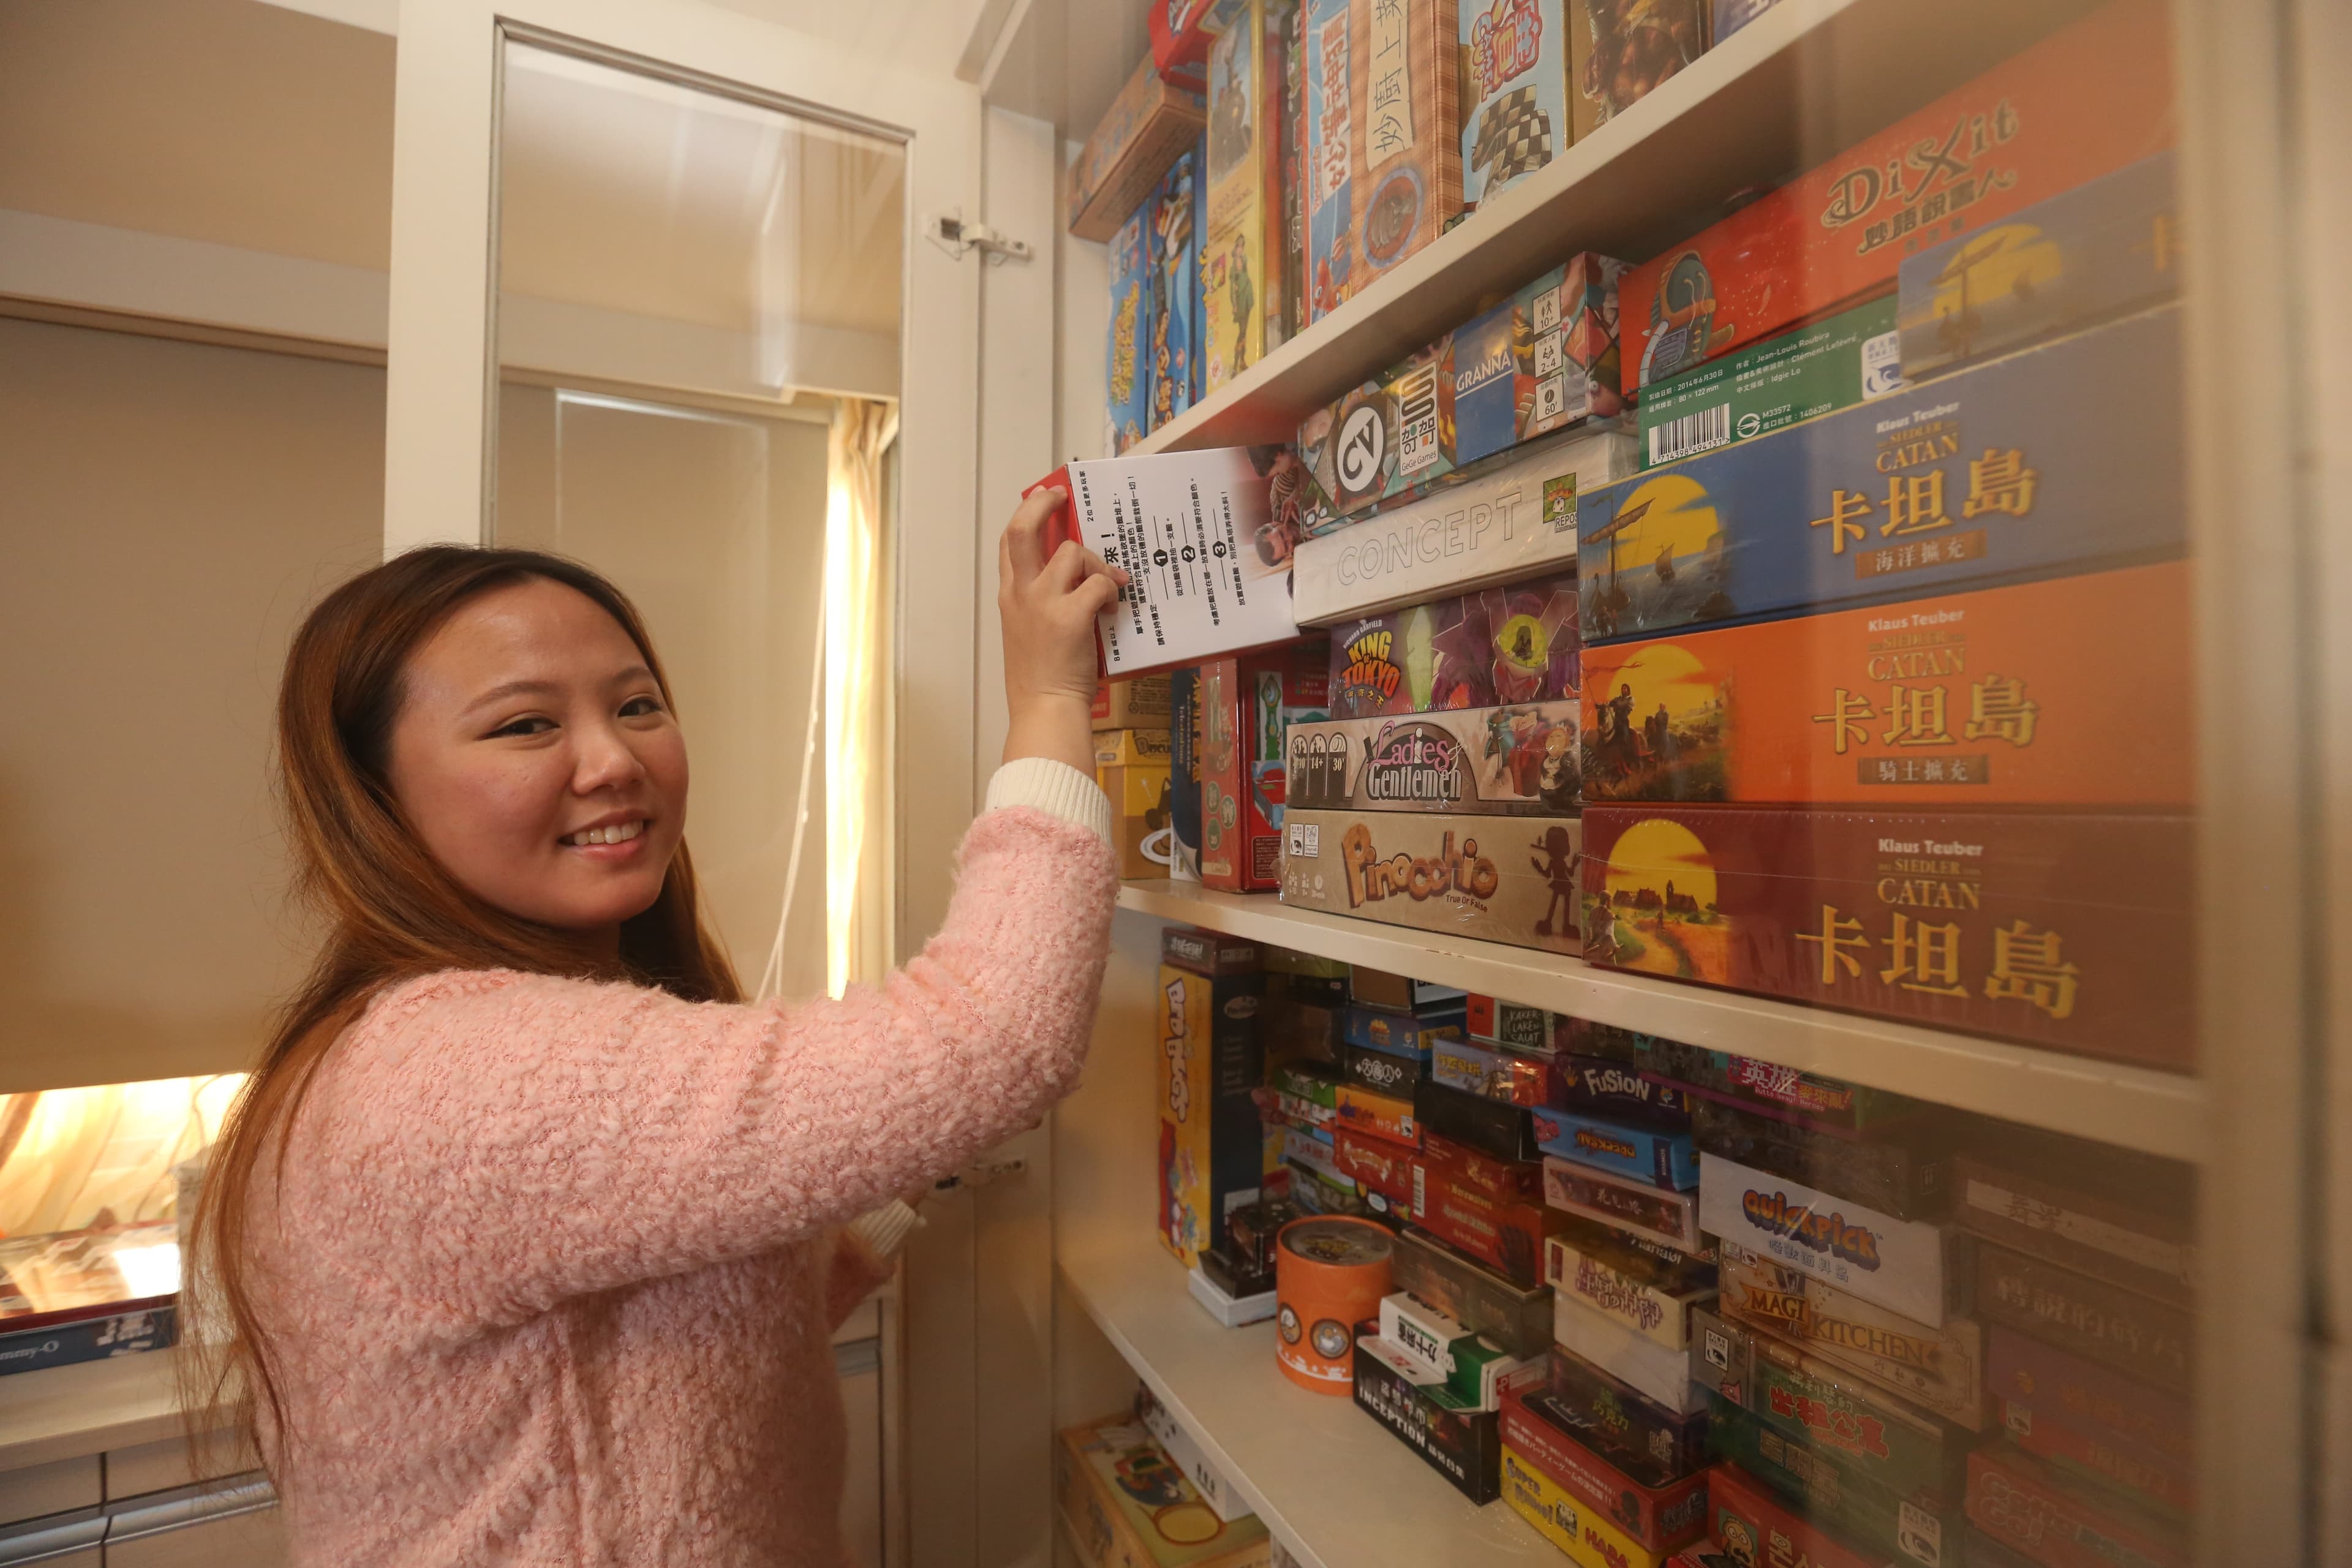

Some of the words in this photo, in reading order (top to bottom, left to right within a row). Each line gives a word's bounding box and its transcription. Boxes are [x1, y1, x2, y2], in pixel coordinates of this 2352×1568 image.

[1540, 316, 1554, 329] 10+
[1756, 344, 1798, 363] Jean-Louis
[1798, 331, 1830, 348] Roubira
[1456, 350, 1511, 393] GRANNA
[1541, 358, 1556, 372] 2-4
[1791, 368, 1801, 376] Lo
[1762, 404, 1792, 419] M33572
[1800, 402, 1833, 418] 1406209
[1875, 417, 1910, 434] Klaus
[1913, 401, 1961, 423] Teuber
[1401, 459, 1417, 471] GeGe
[1417, 451, 1437, 465] Games
[1660, 447, 1689, 463] 714398
[1692, 438, 1723, 453] 494131
[1875, 432, 1960, 475] CATAN
[1810, 448, 2039, 555] 卡坦島
[1337, 491, 1523, 586] CONCEPT
[1875, 540, 1966, 573] 海洋擴充
[1359, 619, 1382, 634] GARFIELD
[1868, 614, 1909, 633] Klaus
[1911, 609, 1965, 627] Teuber
[1348, 631, 1392, 663] KING
[1342, 660, 1401, 698] TOKYO
[1867, 647, 1966, 682] CATAN
[1812, 674, 2040, 755] 卡坦島
[1311, 756, 1324, 769] 14+
[1366, 720, 1452, 775] Ladies
[1368, 765, 1462, 801] Gentlemen
[1879, 760, 1969, 782] 騎士擴充
[1878, 838, 1920, 854] Klaus
[1923, 840, 1984, 857] Teuber
[1341, 823, 1499, 909] Pinocchio
[1446, 894, 1461, 905] True
[1461, 895, 1470, 905] Or
[1470, 898, 1488, 913] False
[1877, 878, 1981, 910] CATAN
[1794, 904, 2080, 1020] 卡坦島
[1510, 1032, 1541, 1044] SALAT
[1754, 1087, 1774, 1098] Butts
[1799, 1098, 1825, 1112] Heroes
[1749, 1289, 1806, 1321] MAGI
[1812, 1319, 1925, 1364] KITCHEN
[1358, 1385, 1426, 1448] INCEPTION
[1585, 1527, 1630, 1567] HABA
